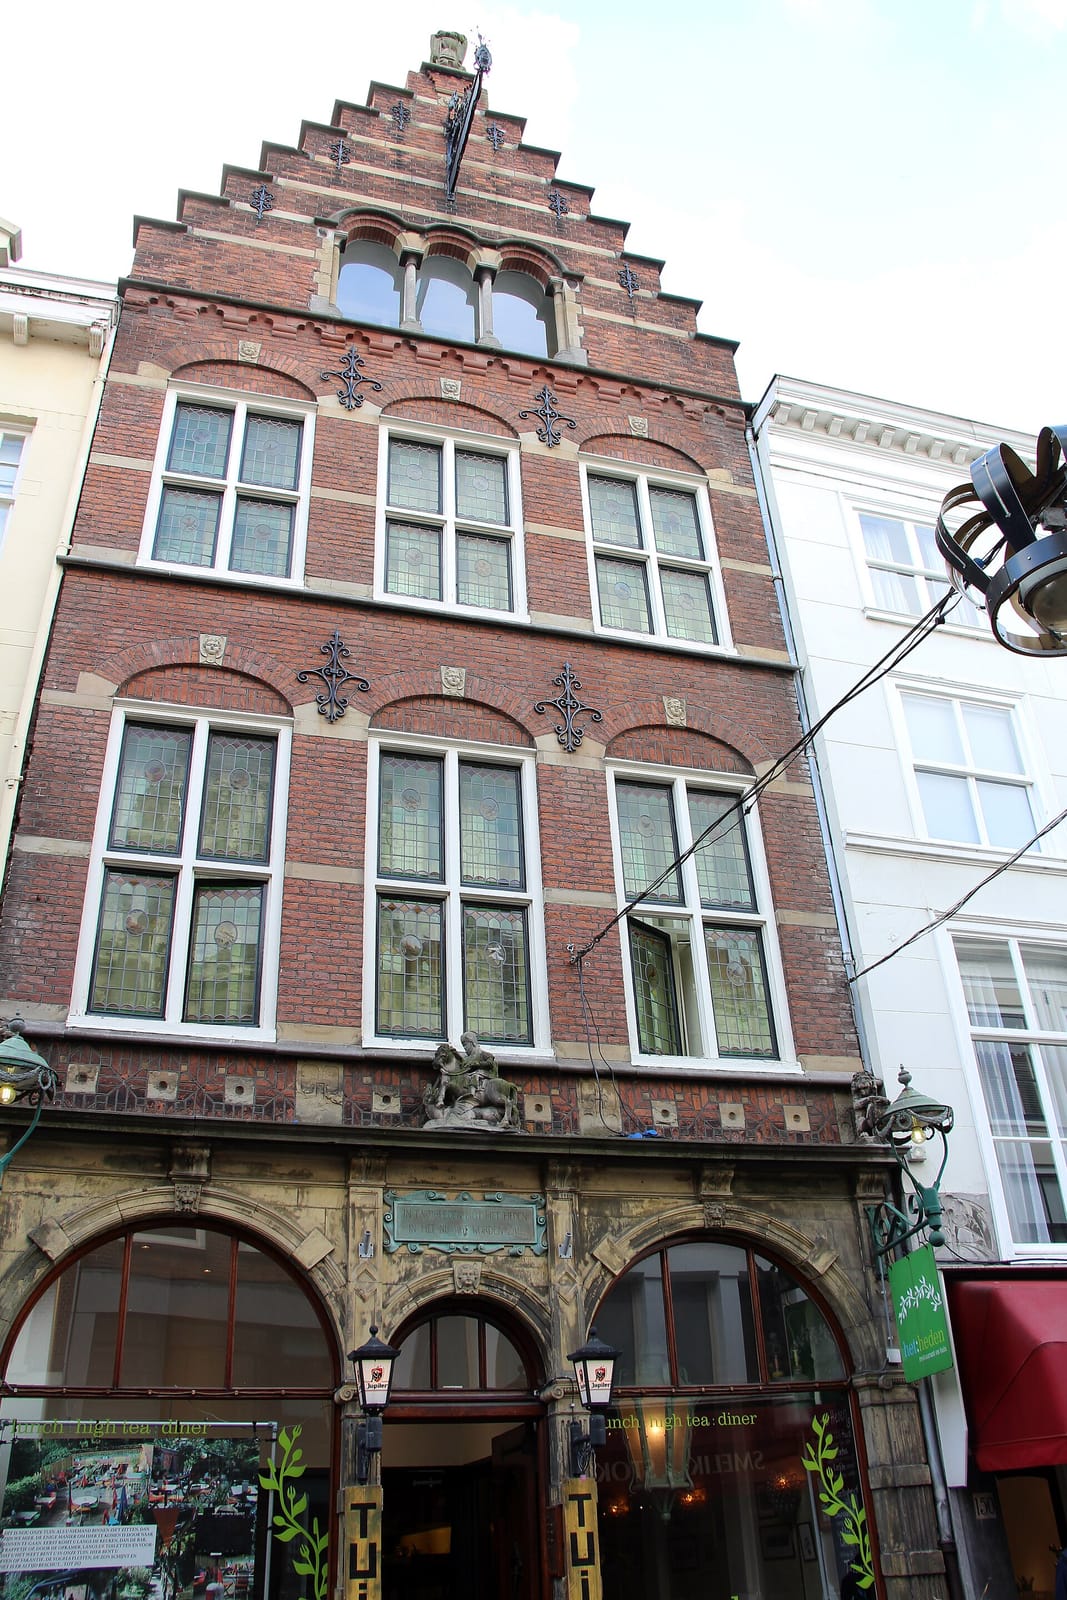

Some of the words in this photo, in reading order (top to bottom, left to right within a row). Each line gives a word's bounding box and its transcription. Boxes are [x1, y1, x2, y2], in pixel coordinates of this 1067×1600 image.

[591, 1382, 610, 1390] Jupiler
[10, 1418, 64, 1434] lunch
[76, 1418, 117, 1438] high
[121, 1420, 151, 1434] tea
[161, 1418, 209, 1434] diner
[605, 1415, 640, 1429] unch
[649, 1413, 683, 1430] high
[686, 1414, 710, 1427] tea
[717, 1411, 758, 1426] diner
